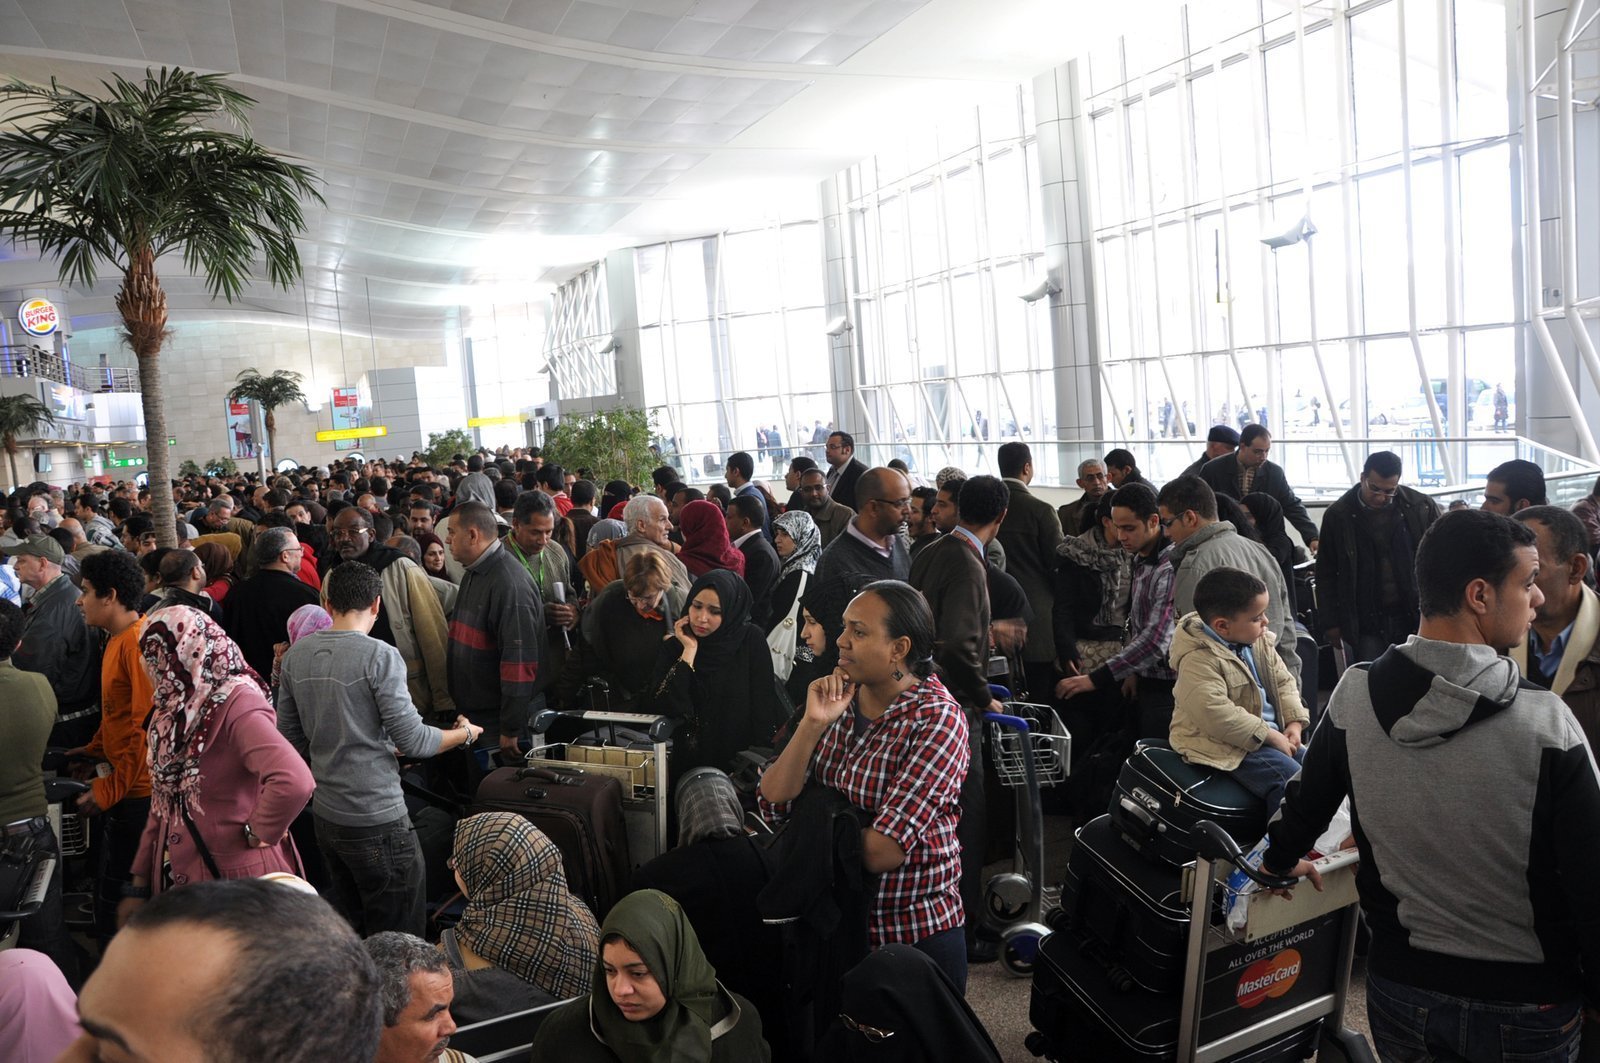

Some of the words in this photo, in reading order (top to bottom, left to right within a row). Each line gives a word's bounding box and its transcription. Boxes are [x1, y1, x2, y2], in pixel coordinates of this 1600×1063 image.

[25, 305, 54, 318] BURGER
[28, 312, 56, 328] KING
[1228, 958, 1245, 969] ALL
[1244, 947, 1267, 962] OVER
[1268, 941, 1284, 953] THE
[1285, 929, 1315, 946] WORLD
[1237, 960, 1300, 997] MasterCard
